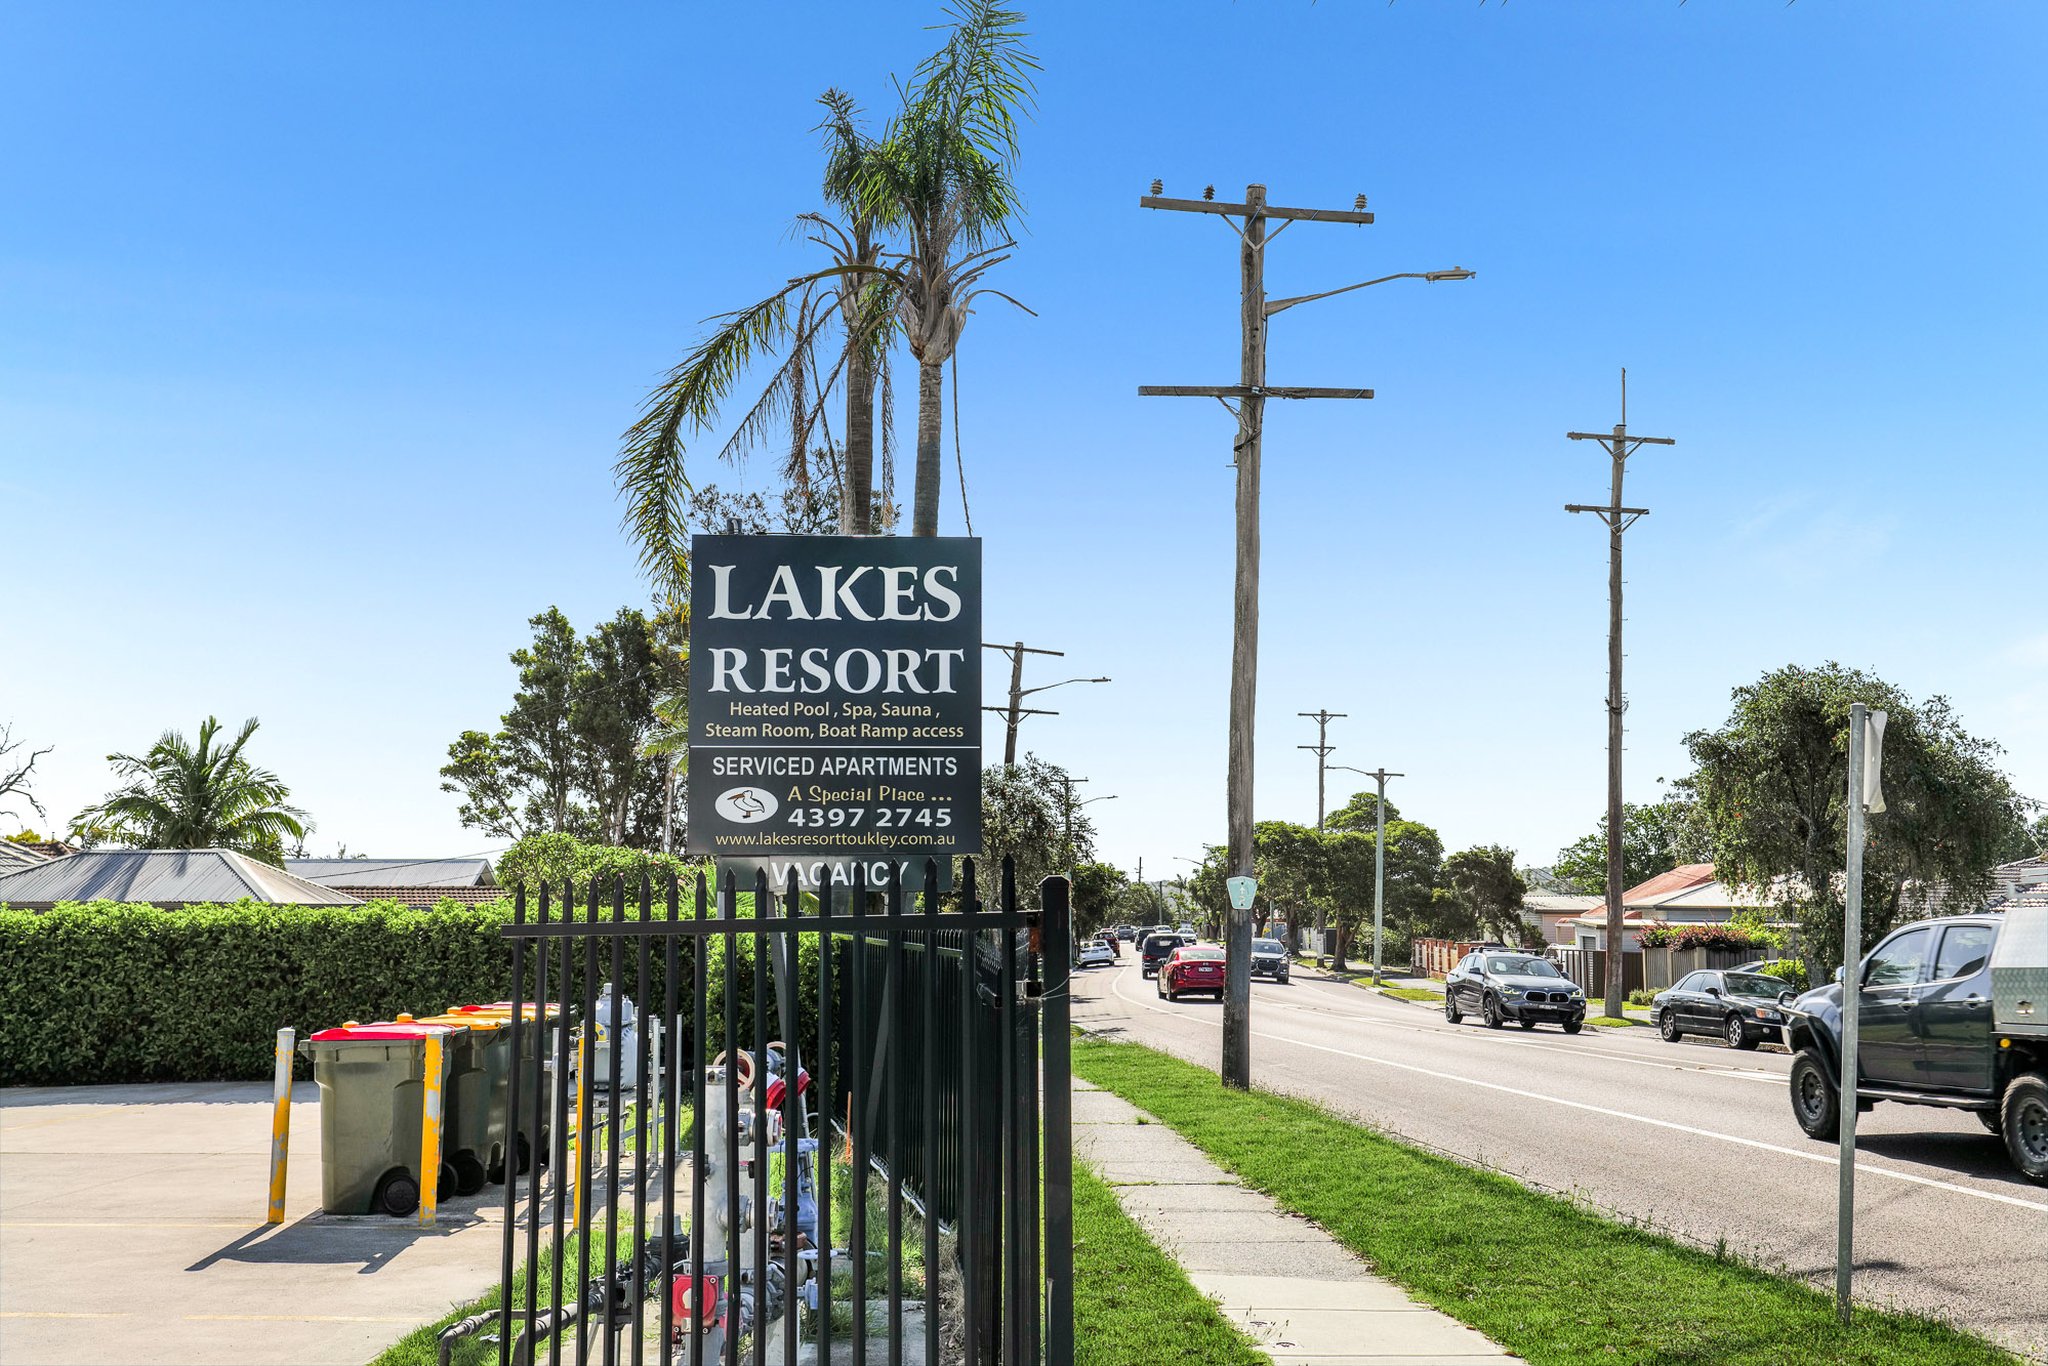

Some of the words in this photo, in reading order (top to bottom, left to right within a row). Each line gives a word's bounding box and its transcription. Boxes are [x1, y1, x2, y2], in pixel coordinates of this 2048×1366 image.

[708, 565, 961, 622] LAKES
[708, 648, 964, 694] RESORT
[731, 702, 789, 716] Heated
[843, 702, 876, 719] Spa,
[706, 723, 757, 737] Steam
[762, 723, 814, 739] Room,
[820, 723, 856, 737] Boat
[861, 724, 908, 741] Ramp
[912, 727, 963, 737] access
[713, 757, 814, 775] SERVICED
[820, 757, 957, 775] APARTMENTS
[788, 786, 802, 801] A
[808, 785, 871, 805] Special
[880, 786, 925, 801] Place
[788, 808, 864, 827] 4397
[876, 808, 951, 827] 2745
[715, 832, 954, 848] www.lakesresorttoukley.com.au
